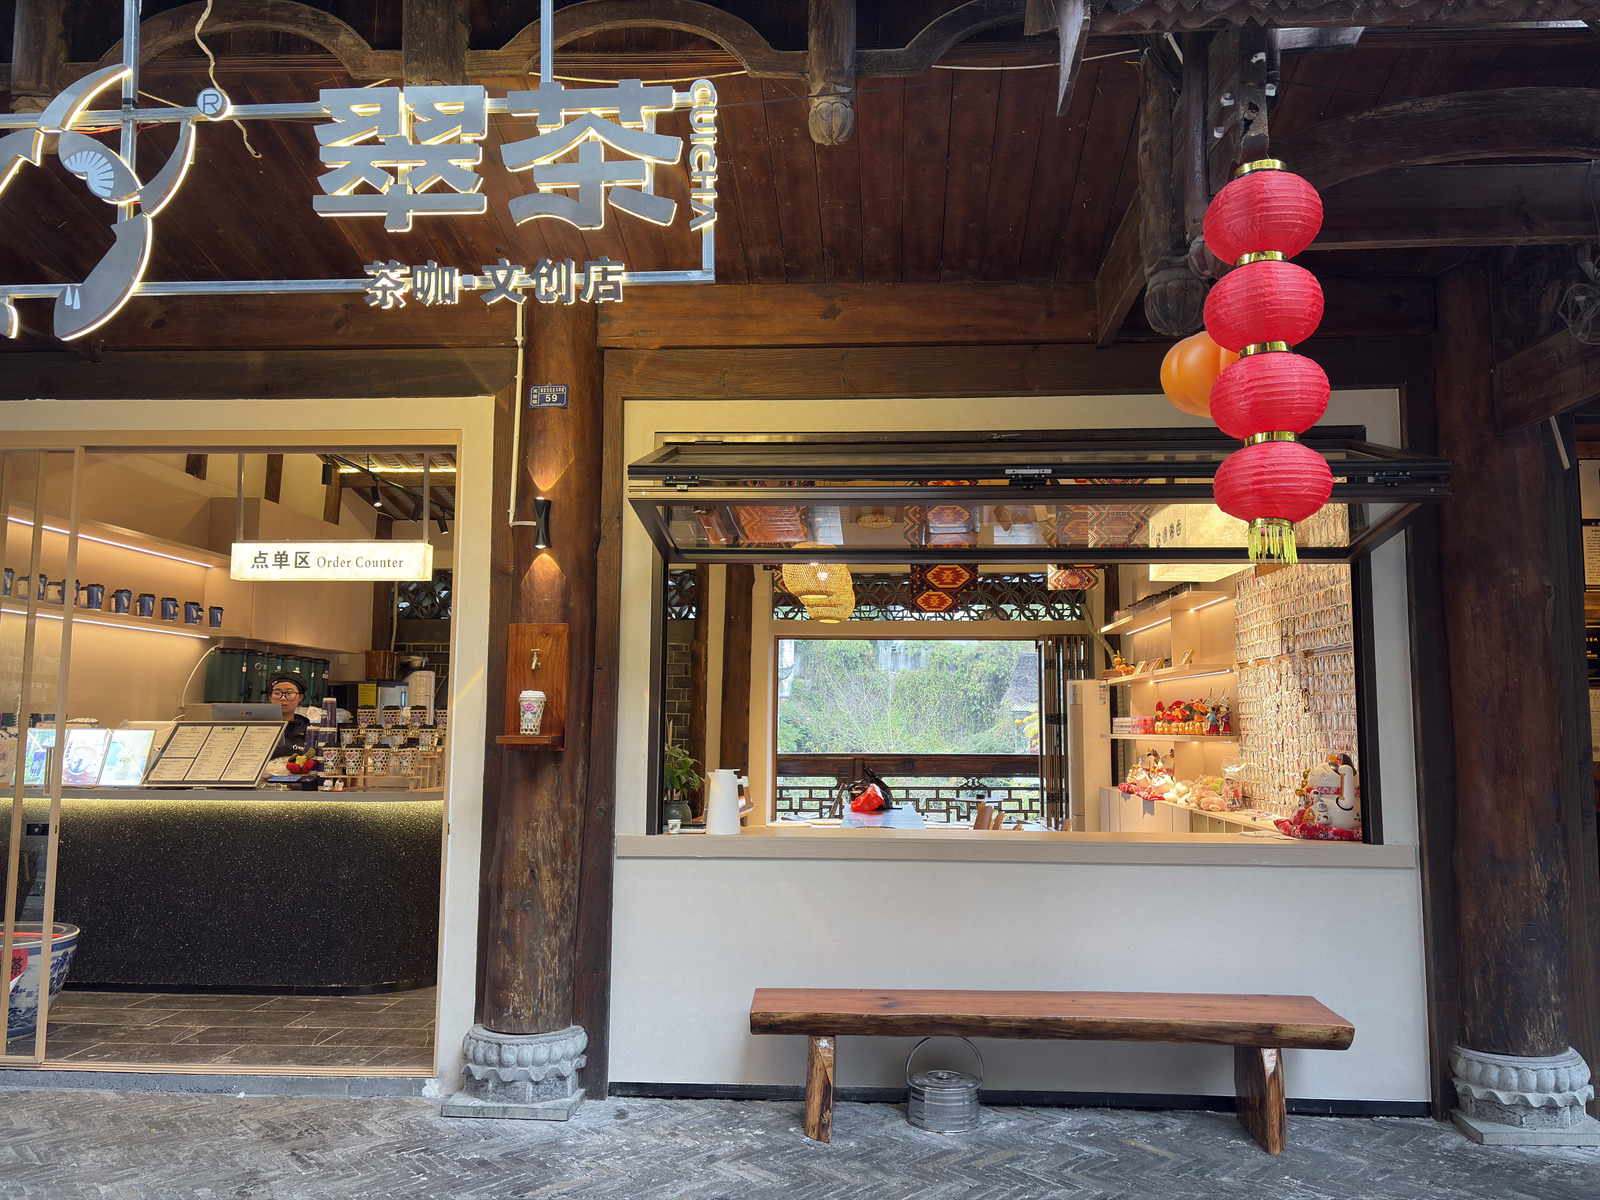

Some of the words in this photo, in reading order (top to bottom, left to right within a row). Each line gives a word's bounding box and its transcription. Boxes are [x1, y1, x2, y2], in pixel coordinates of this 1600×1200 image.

[313, 79, 682, 232] 翠茶
[689, 79, 718, 231] CUICHA
[545, 394, 558, 402] 59
[251, 550, 311, 569] 点单区
[316, 556, 352, 568] Order
[355, 556, 404, 568] Counter
